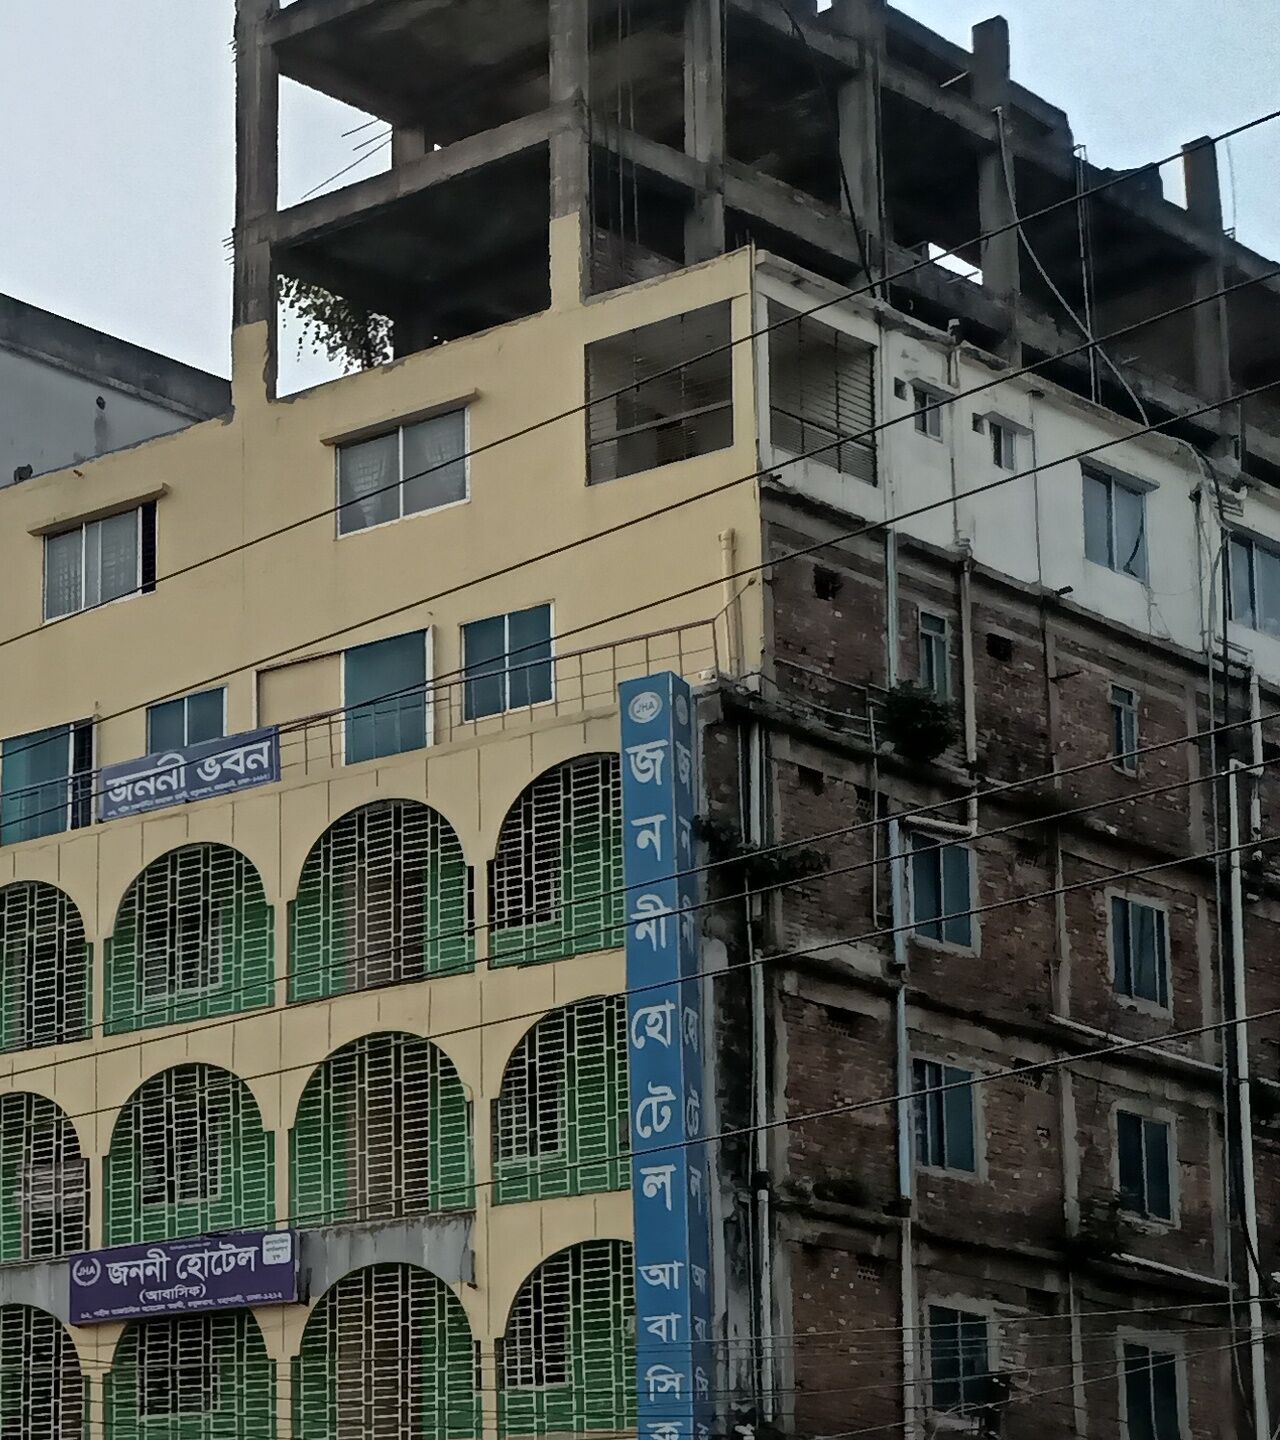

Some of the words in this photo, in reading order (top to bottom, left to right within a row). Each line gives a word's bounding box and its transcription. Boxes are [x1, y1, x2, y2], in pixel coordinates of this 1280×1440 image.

[106, 753, 187, 802] জননী
[197, 740, 271, 781] ভবন
[106, 1248, 171, 1286] জননী
[176, 1242, 259, 1281] হোটেল
[139, 1283, 207, 1303] (আবাসিক)
